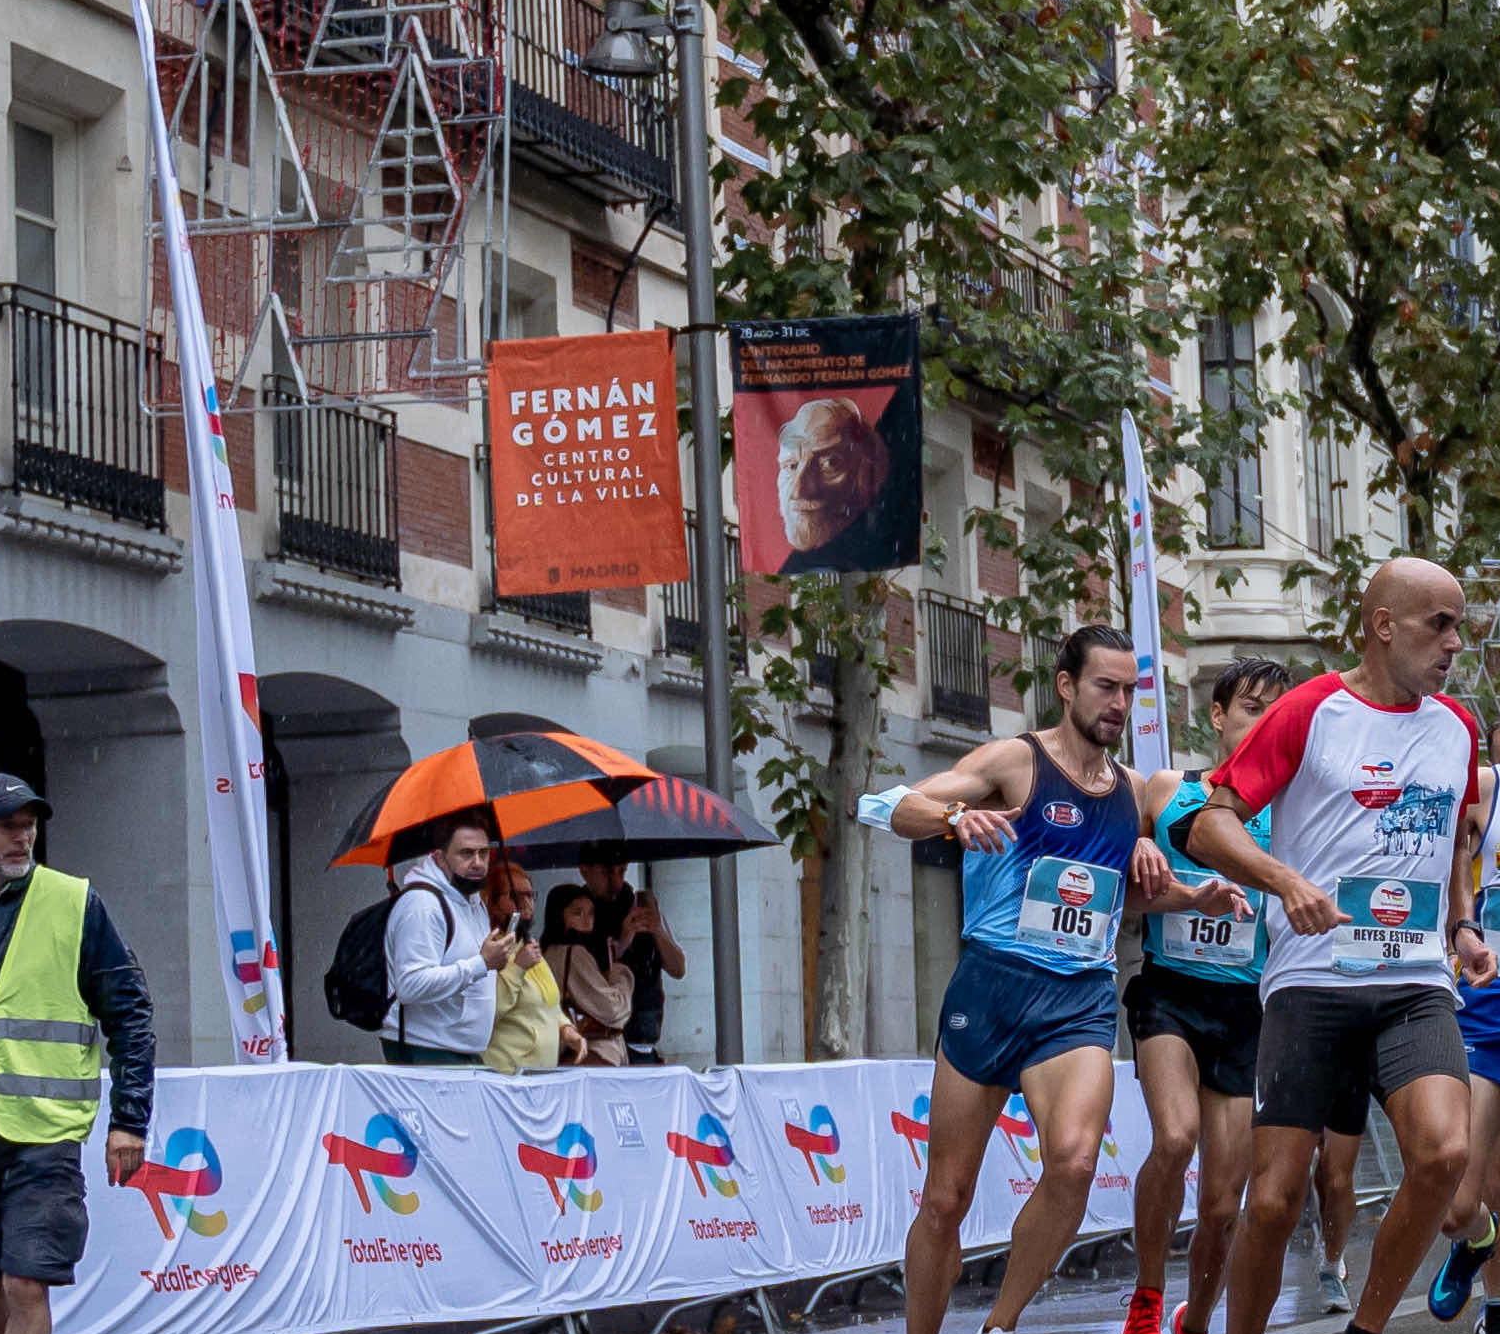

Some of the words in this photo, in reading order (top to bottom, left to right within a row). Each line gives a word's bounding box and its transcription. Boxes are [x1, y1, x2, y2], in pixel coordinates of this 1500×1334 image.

[740, 343, 821, 357] CENTENARIO
[766, 355, 845, 370] NACIMIENTO
[850, 355, 866, 367] DE
[741, 370, 810, 385] FERNANDO
[510, 377, 656, 415] FERNÁN
[512, 413, 657, 446] GÓMEZ
[543, 448, 630, 466] CENTRO
[531, 465, 644, 487] CULTURAL
[516, 492, 543, 507] DE
[557, 490, 583, 504] LA
[596, 483, 660, 501] VILLA
[570, 563, 639, 580] MADRID
[1051, 905, 1093, 937] 105
[1188, 917, 1232, 946] 150
[1353, 928, 1386, 942] REYES
[1382, 942, 1401, 958] 36
[344, 1237, 443, 1268] TotalEnergies
